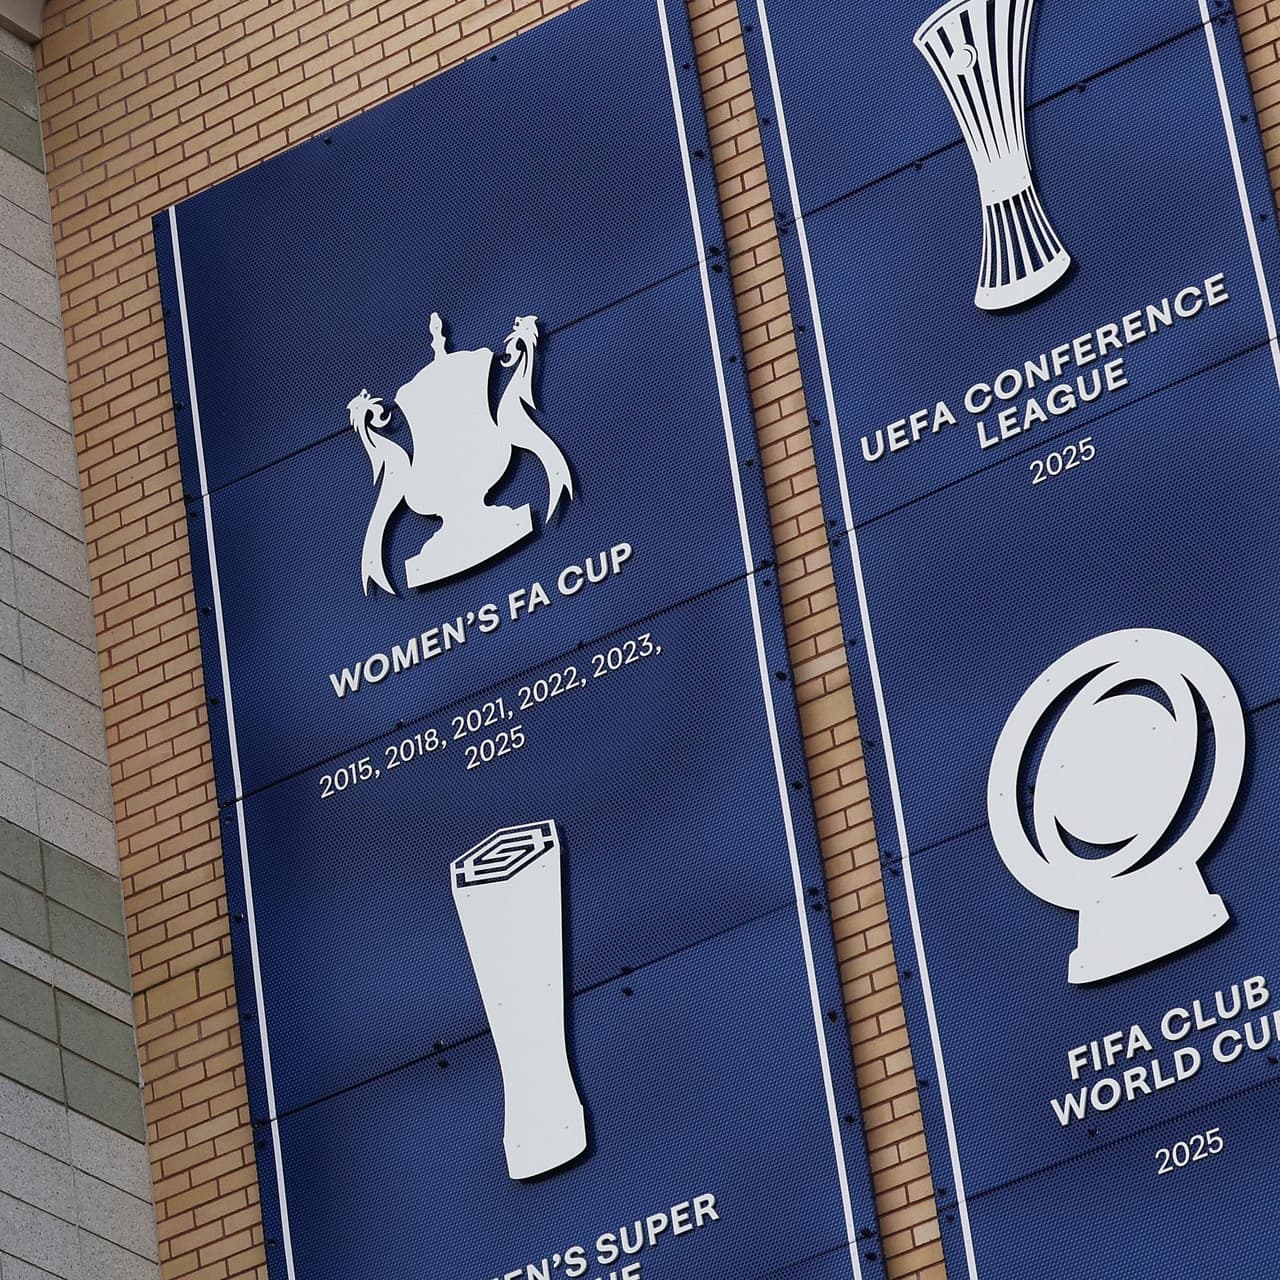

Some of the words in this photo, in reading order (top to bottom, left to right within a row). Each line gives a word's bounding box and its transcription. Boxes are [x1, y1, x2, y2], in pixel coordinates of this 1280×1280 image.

[860, 400, 957, 462] UEFA
[963, 272, 1229, 415] CONFERENCE
[977, 358, 1129, 449] LEAGUE
[1029, 437, 1096, 485] 2025
[329, 604, 500, 698] WOMEN’S
[508, 582, 551, 620] FA
[557, 542, 633, 596] CUP
[319, 758, 381, 798] 2015,
[385, 729, 447, 769] 2018,
[451, 698, 513, 740] 2021,
[518, 667, 587, 710] 2022,
[591, 633, 662, 678] 2023,
[464, 725, 525, 769] 2025
[1067, 1024, 1152, 1080] FIFA
[1160, 975, 1270, 1041] CLUB
[1050, 1046, 1201, 1126] WORLD
[1155, 1128, 1224, 1175] 2025
[596, 1193, 720, 1265] SUPER
